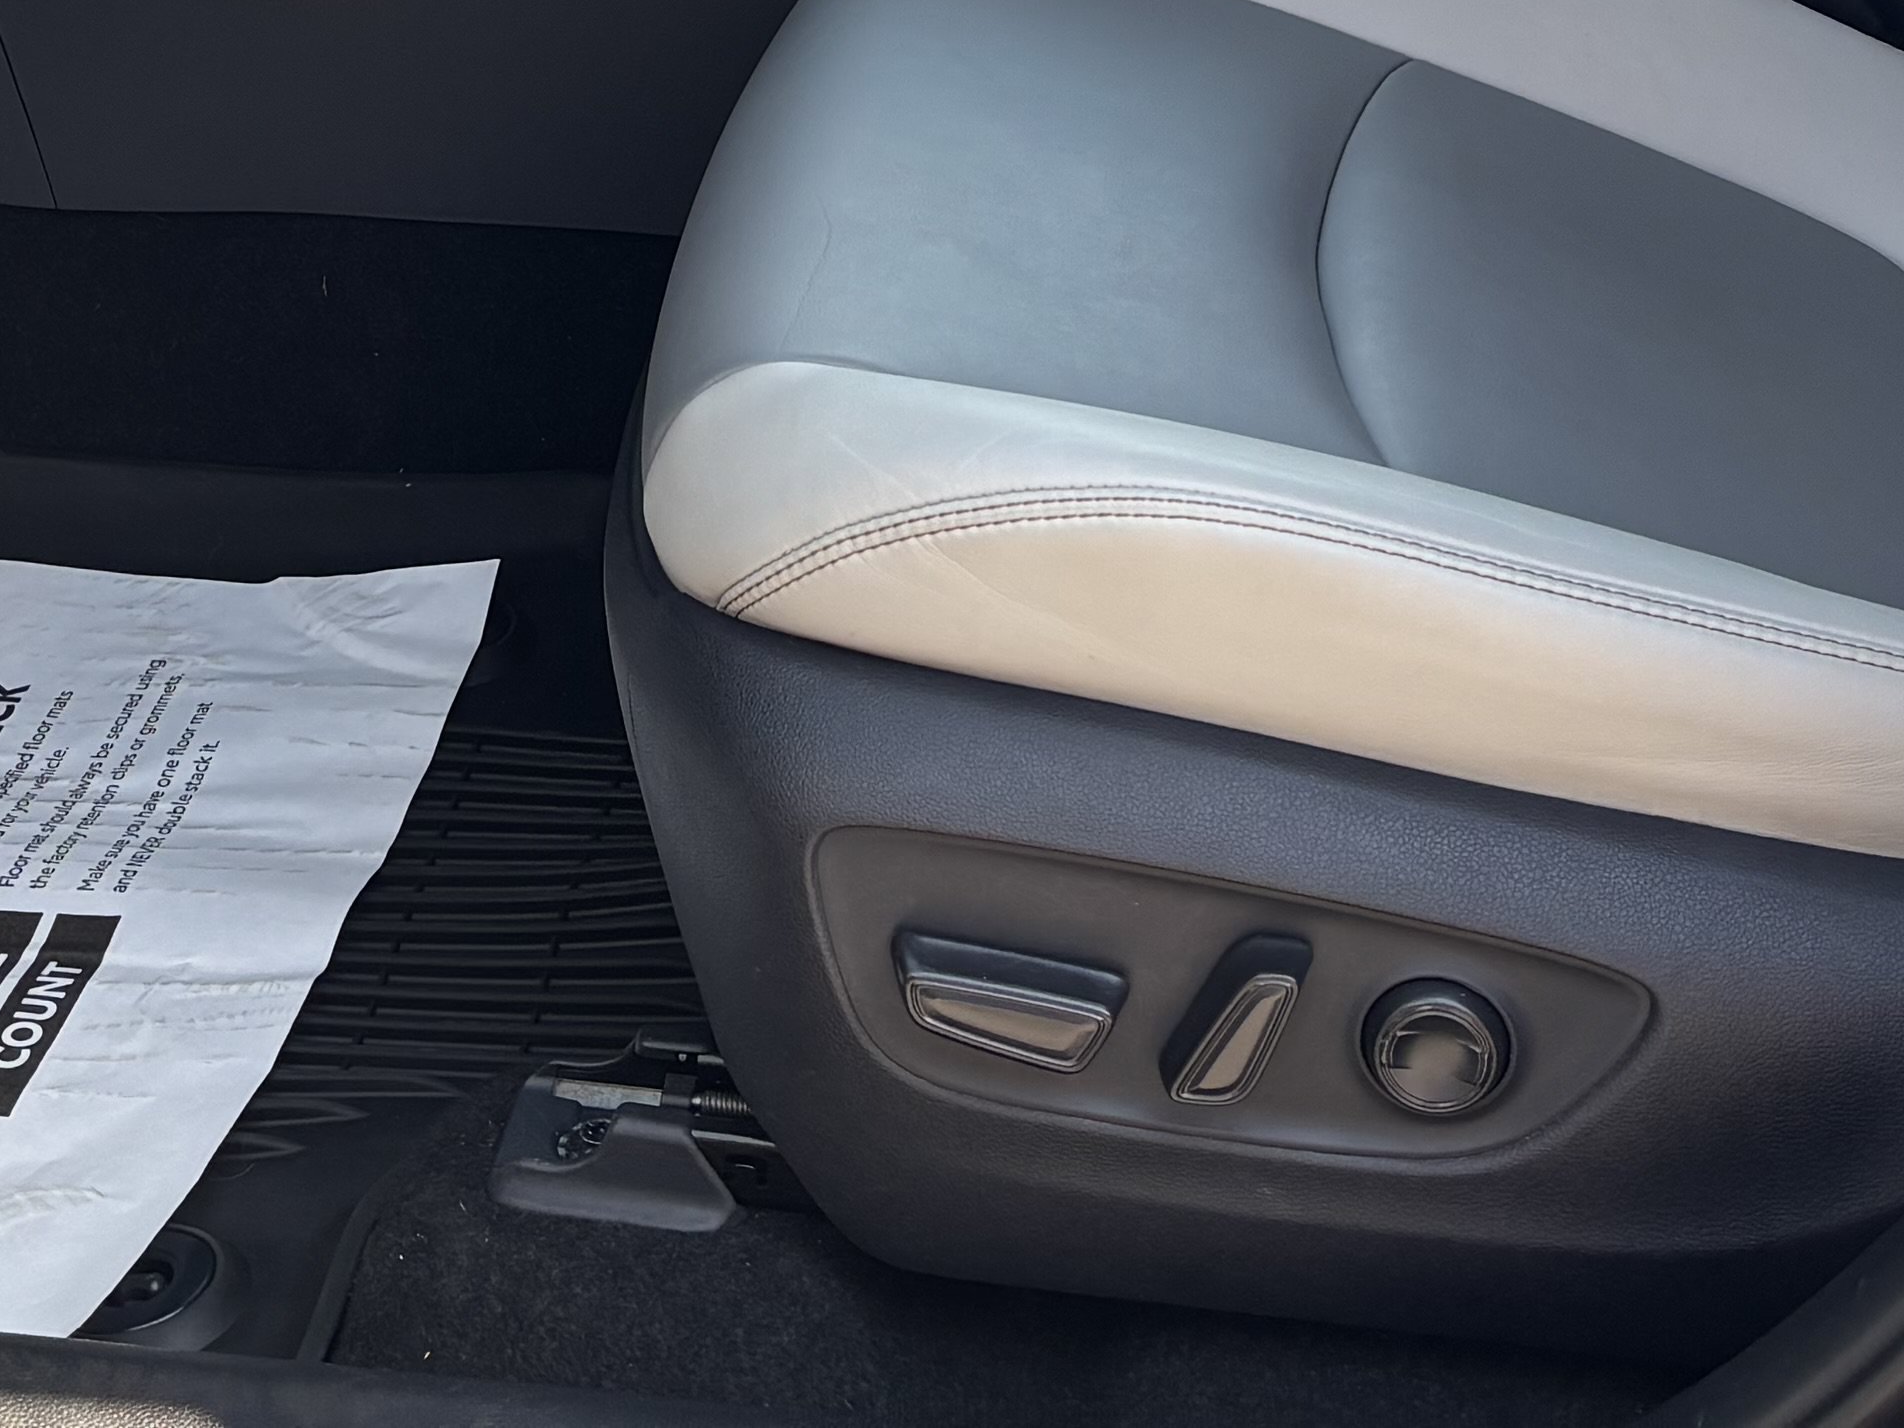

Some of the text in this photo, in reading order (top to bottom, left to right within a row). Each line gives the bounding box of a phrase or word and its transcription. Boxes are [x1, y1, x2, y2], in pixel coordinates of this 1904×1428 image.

[22, 721, 54, 751] floor
[46, 689, 74, 719] mats
[12, 790, 38, 814] your
[31, 746, 70, 791] vehicle.
[24, 833, 50, 853] mat
[39, 800, 77, 833] should
[68, 761, 103, 800] always
[90, 742, 114, 759] be
[106, 693, 144, 740] secured
[135, 659, 167, 690] using
[29, 673, 185, 889] the factory retention clips or grommets.
[185, 756, 213, 792] stack
[76, 702, 213, 891] Make sure you have one floor mat
[154, 794, 193, 835] double
[113, 869, 138, 893] and
[125, 836, 166, 867] NEVER
